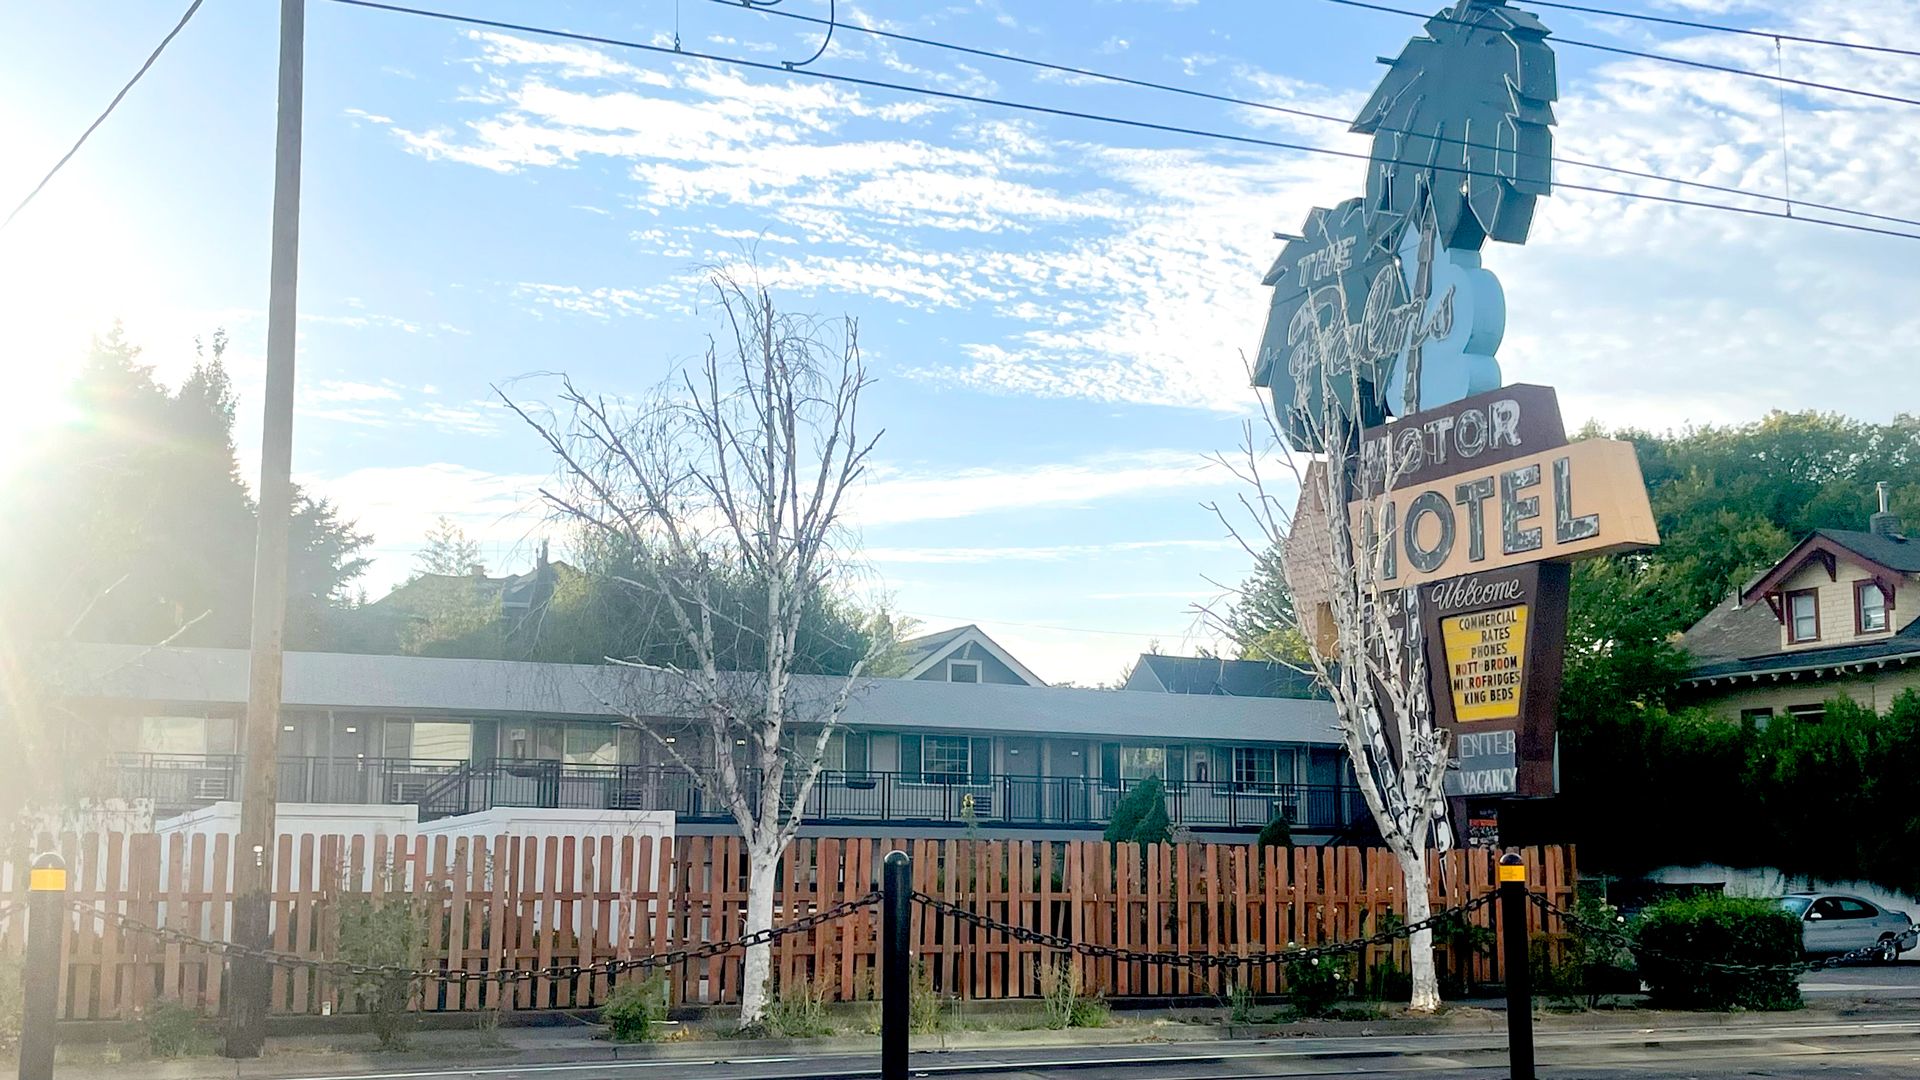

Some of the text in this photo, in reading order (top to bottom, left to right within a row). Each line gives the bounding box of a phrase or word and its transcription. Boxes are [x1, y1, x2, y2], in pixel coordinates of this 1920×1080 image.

[1298, 236, 1357, 287] THE
[1287, 264, 1456, 378] Palms
[1360, 400, 1521, 482] MOTOR
[1362, 457, 1599, 580] HOTEL
[1431, 577, 1525, 610] Welcome
[1459, 610, 1517, 631] COMMERCIAL
[1481, 626, 1510, 643] RATES
[1471, 642, 1507, 659] PHONES
[1464, 687, 1513, 704] KING BEDS
[1461, 730, 1516, 757] ENTER
[1460, 767, 1518, 793] VACANCY
